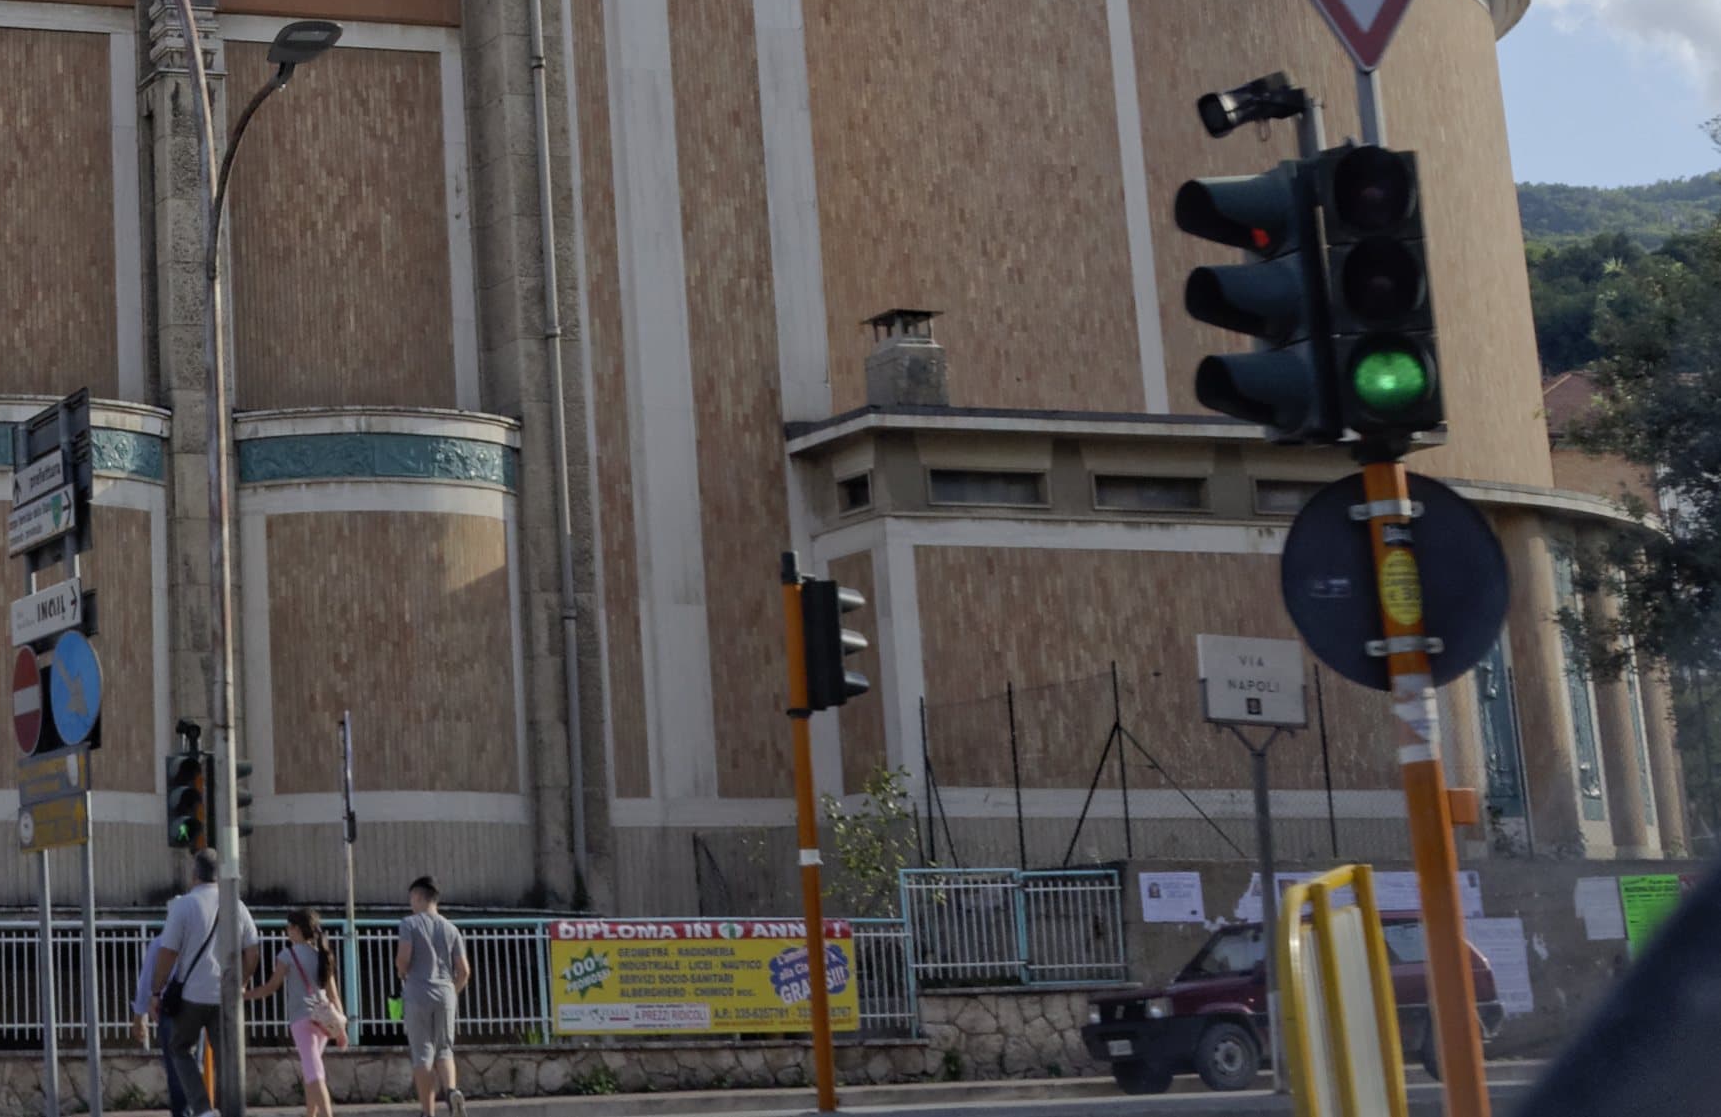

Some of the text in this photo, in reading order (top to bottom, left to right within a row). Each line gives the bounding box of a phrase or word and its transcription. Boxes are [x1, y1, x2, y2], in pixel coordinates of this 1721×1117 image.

[1239, 654, 1264, 667] VIA
[1227, 679, 1280, 693] NAPOLI
[558, 920, 678, 940] DIPLOMA
[684, 922, 712, 938] IN
[751, 923, 826, 938] ANN
[780, 964, 847, 1005] GRAS!!!
